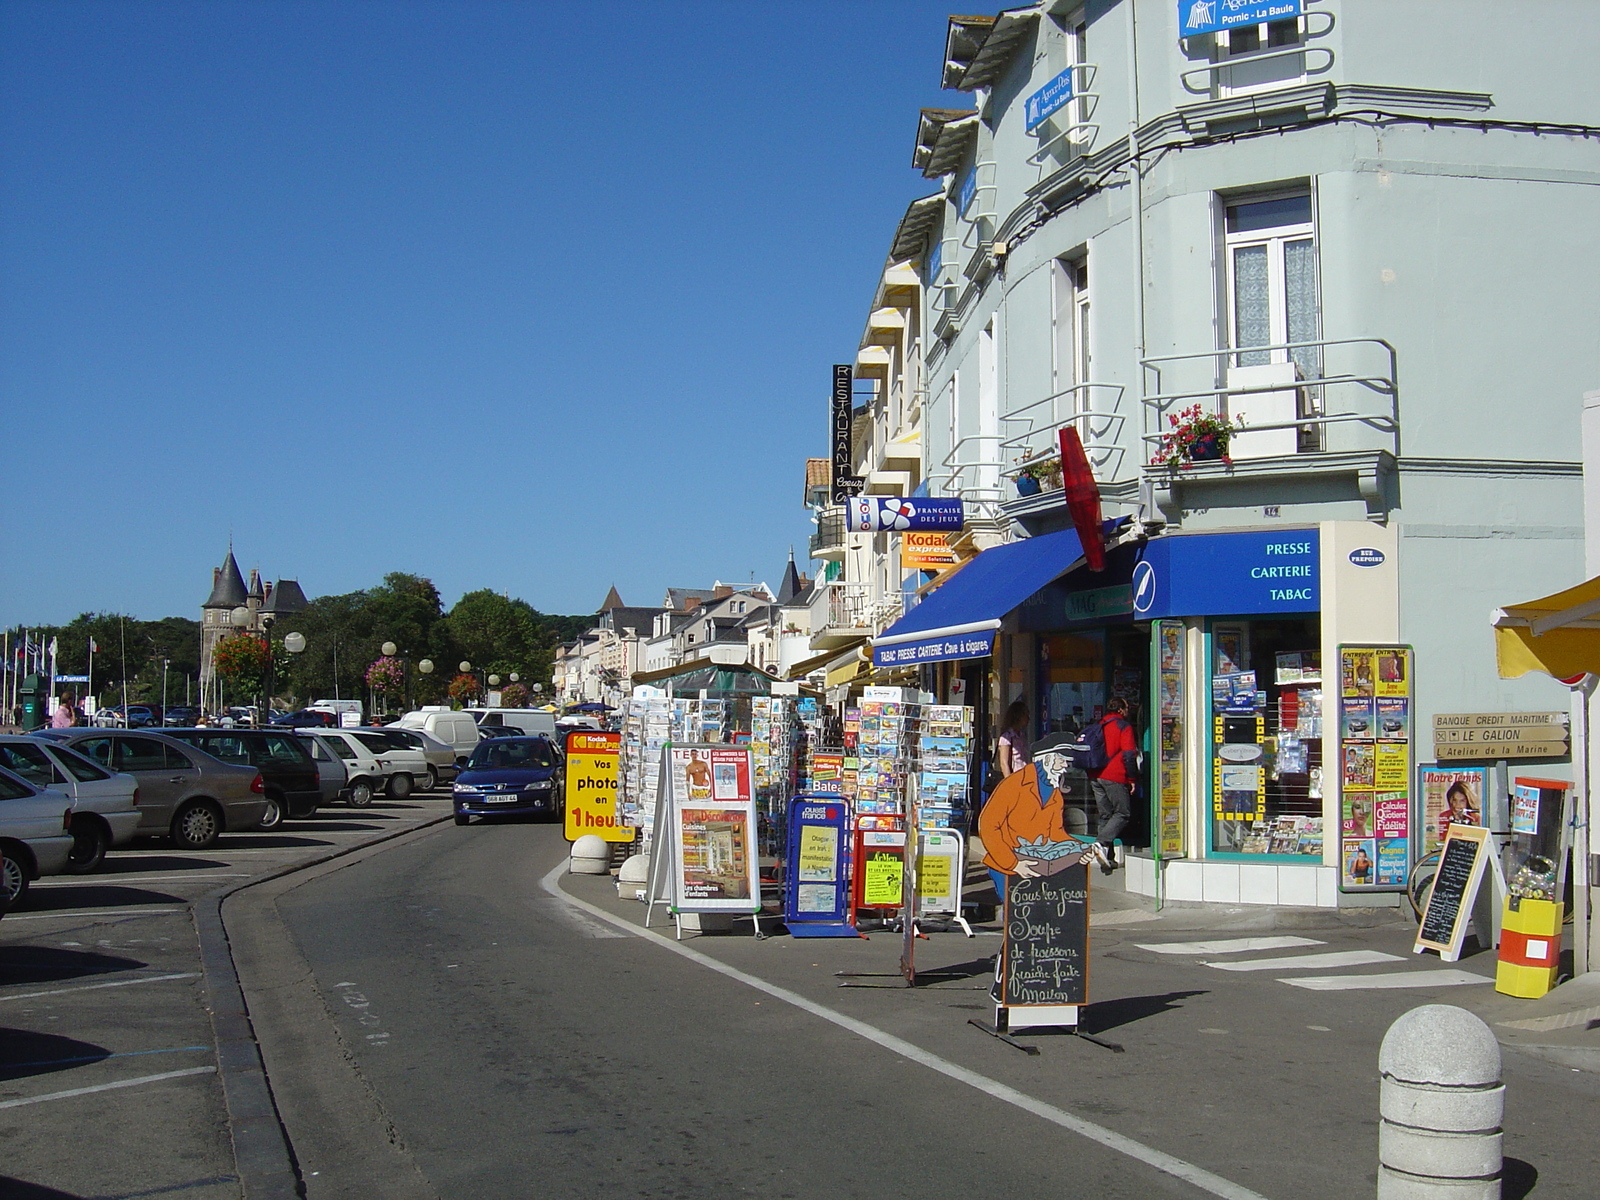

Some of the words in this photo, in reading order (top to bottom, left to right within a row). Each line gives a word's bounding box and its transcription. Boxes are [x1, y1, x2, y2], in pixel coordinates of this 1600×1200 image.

[1222, 12, 1250, 25] Pornic
[1256, 9, 1267, 18] La
[1269, 4, 1294, 16] Baule
[836, 366, 849, 476] RESTAURANT
[907, 533, 950, 547] Kodak
[907, 546, 953, 554] express
[1266, 542, 1311, 556] PRESSE
[1250, 565, 1312, 579] CARTERIE
[1269, 588, 1312, 601] TABAC
[880, 650, 896, 663] TABAC
[897, 647, 916, 660] PRESSE
[917, 643, 943, 658] CARTERIE
[944, 642, 958, 655] Cave
[959, 640, 965, 653] à
[965, 639, 989, 655] cigares
[1436, 716, 1470, 726] BANQUE
[1476, 715, 1504, 725] CREDIT
[1509, 714, 1549, 724] MARITIME
[1462, 730, 1474, 741] LE
[1482, 729, 1520, 741] GALION
[1485, 746, 1496, 755] de
[1501, 745, 1510, 754] la
[1516, 744, 1548, 754] Marine
[594, 760, 611, 769] Vos
[1427, 772, 1453, 783] Notre
[1453, 772, 1482, 784] Temps
[1376, 792, 1402, 801] TEST
[1381, 802, 1406, 810] Calculez
[571, 807, 582, 827] 1
[801, 811, 826, 819] france
[1376, 809, 1406, 820] Quotient
[1376, 820, 1406, 830] Fidélité
[1041, 881, 1059, 901] les
[1008, 905, 1061, 944] Soupe
[1010, 943, 1025, 959] de
[1053, 959, 1081, 988] faite
